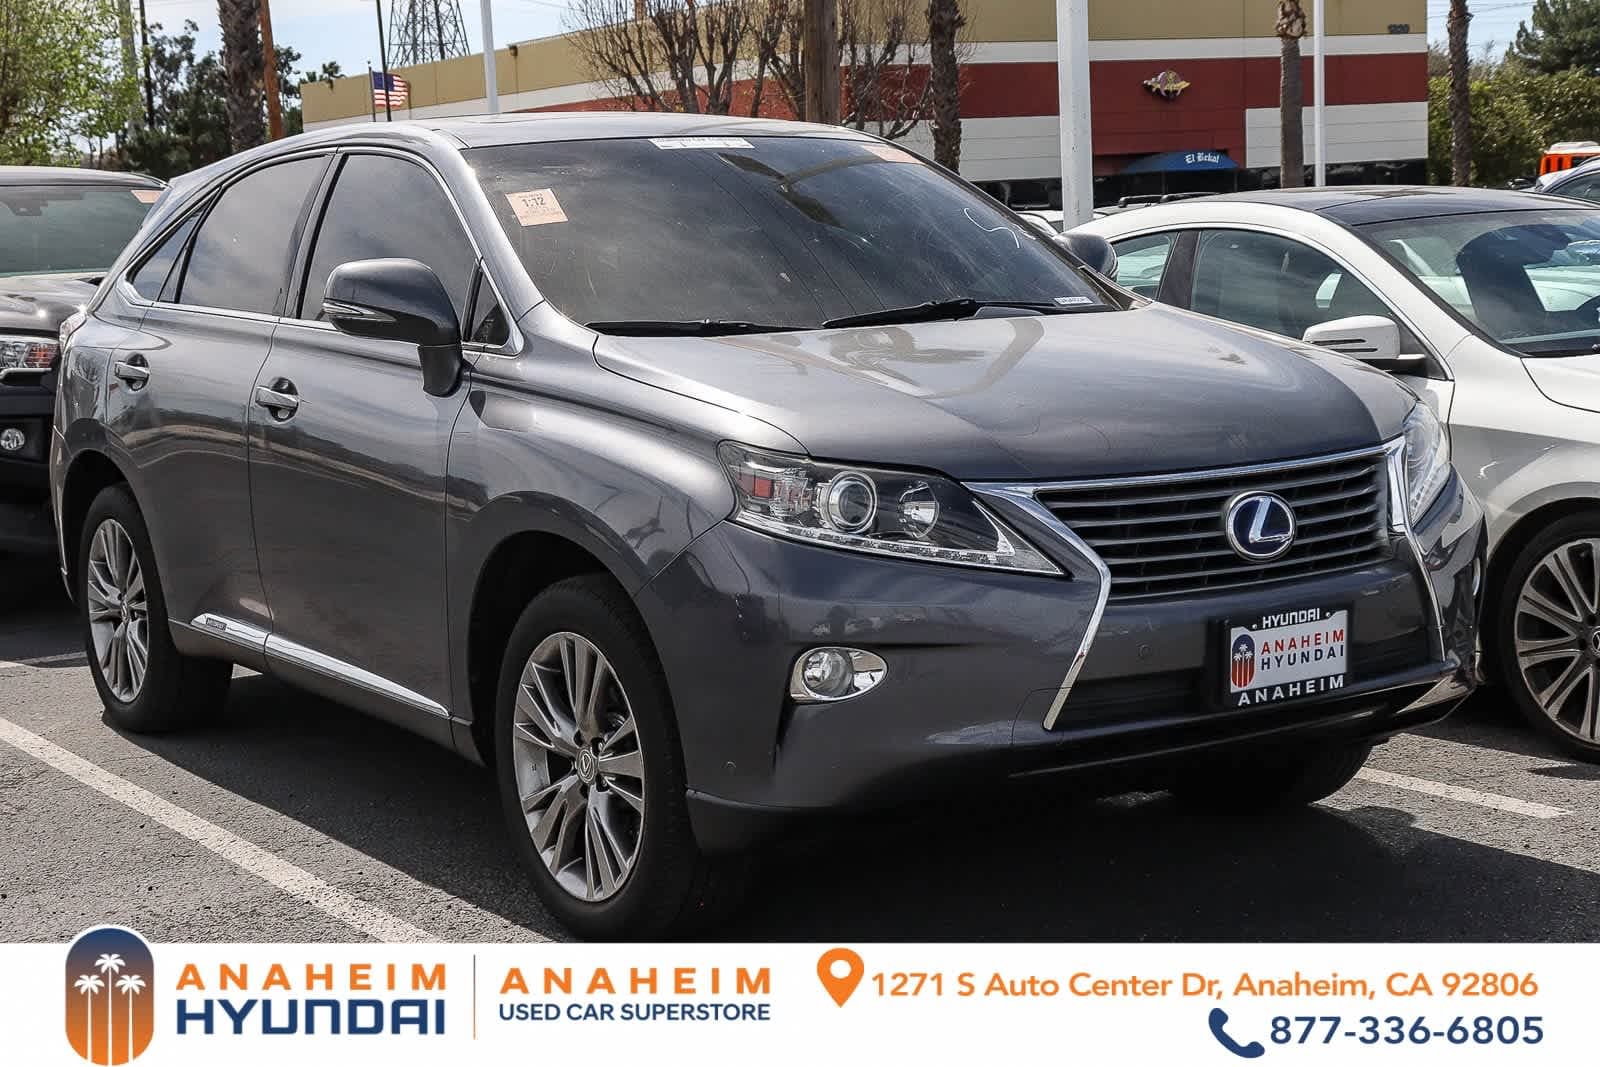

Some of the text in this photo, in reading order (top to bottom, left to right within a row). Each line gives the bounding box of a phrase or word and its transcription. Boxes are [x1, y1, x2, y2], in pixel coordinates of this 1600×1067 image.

[1185, 153, 1196, 164] El
[1262, 608, 1320, 628] HYUNDAI
[1261, 629, 1344, 655] ANAHEIM
[1261, 645, 1344, 671] HYUNDAI
[1238, 675, 1344, 706] ANAHEIM
